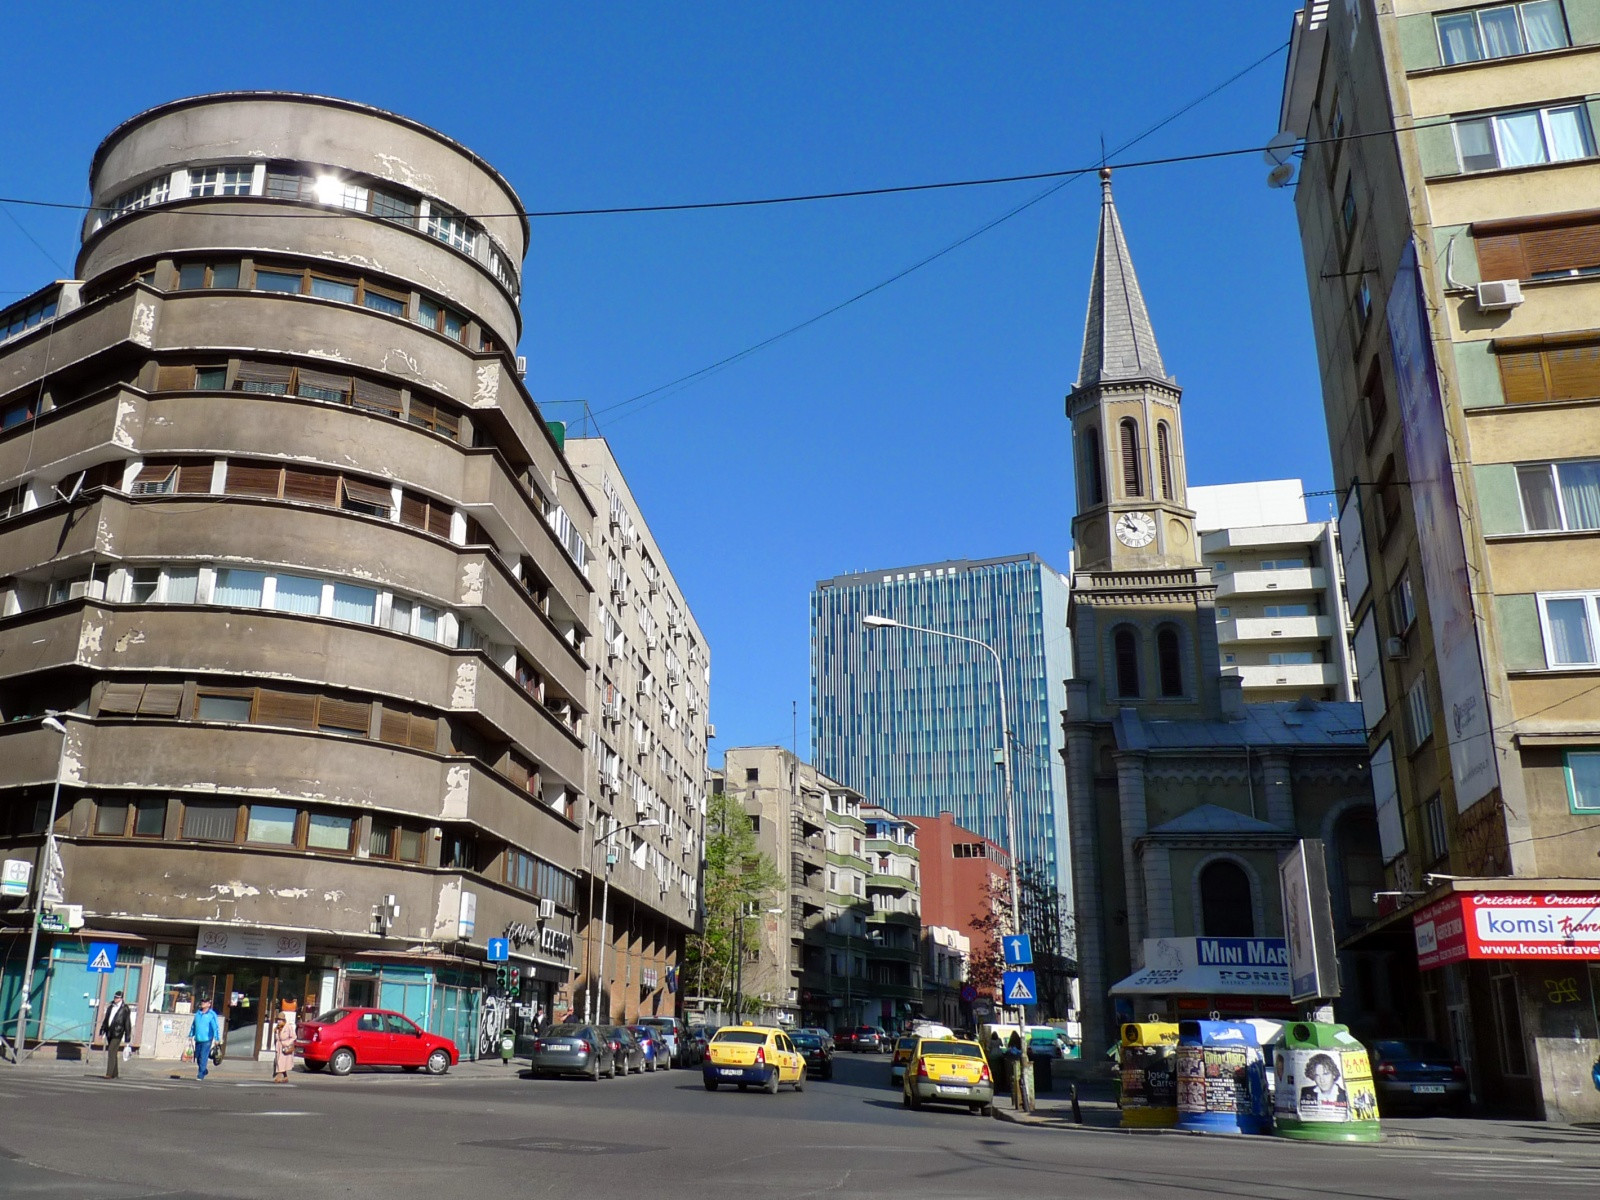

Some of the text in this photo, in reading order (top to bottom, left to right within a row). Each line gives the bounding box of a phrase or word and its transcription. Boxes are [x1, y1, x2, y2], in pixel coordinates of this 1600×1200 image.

[1487, 911, 1600, 933] komsi trave
[1201, 940, 1288, 964] MINI MAR
[1147, 969, 1183, 977] NON
[1135, 977, 1178, 985] STOP
